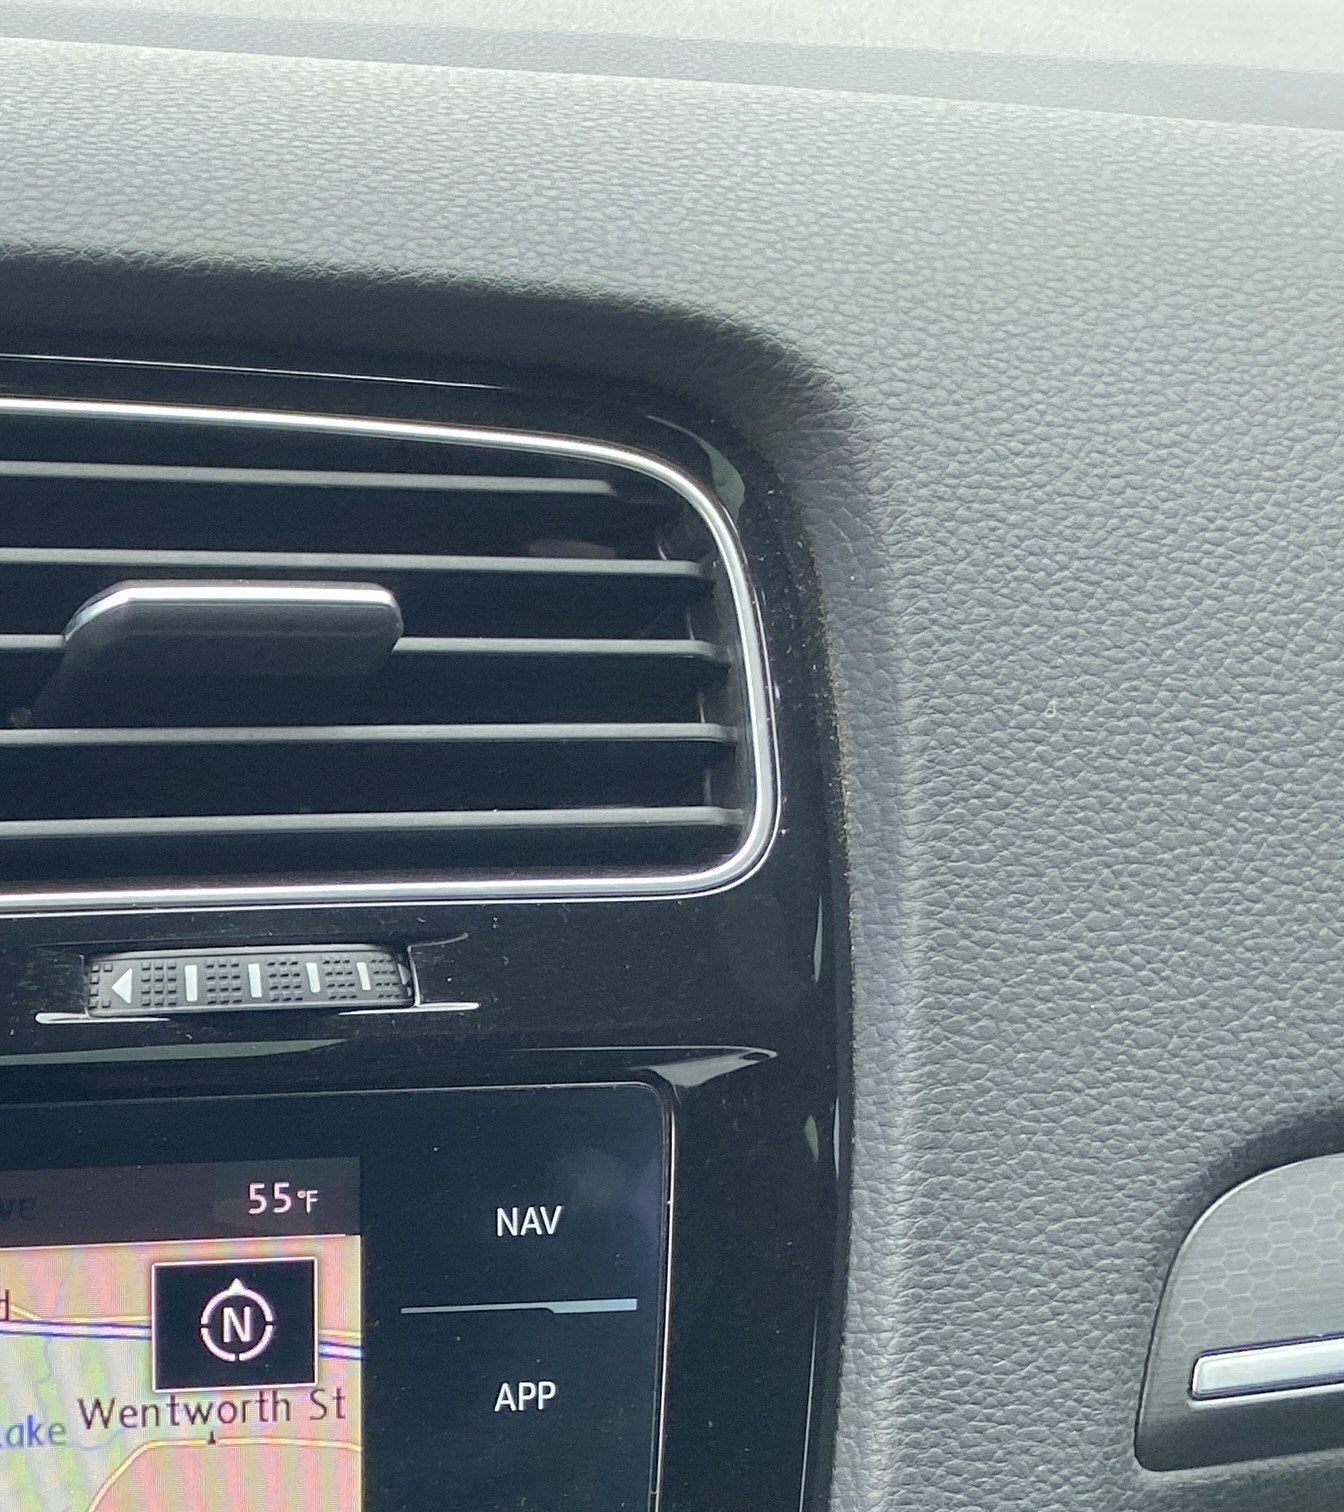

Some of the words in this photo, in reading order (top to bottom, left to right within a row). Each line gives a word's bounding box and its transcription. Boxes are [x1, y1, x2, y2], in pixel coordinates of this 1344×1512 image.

[496, 1205, 563, 1237] NAV
[222, 1306, 252, 1343] N
[78, 1389, 292, 1430] Wentworth
[309, 1387, 347, 1422] St
[494, 1381, 556, 1412] APP
